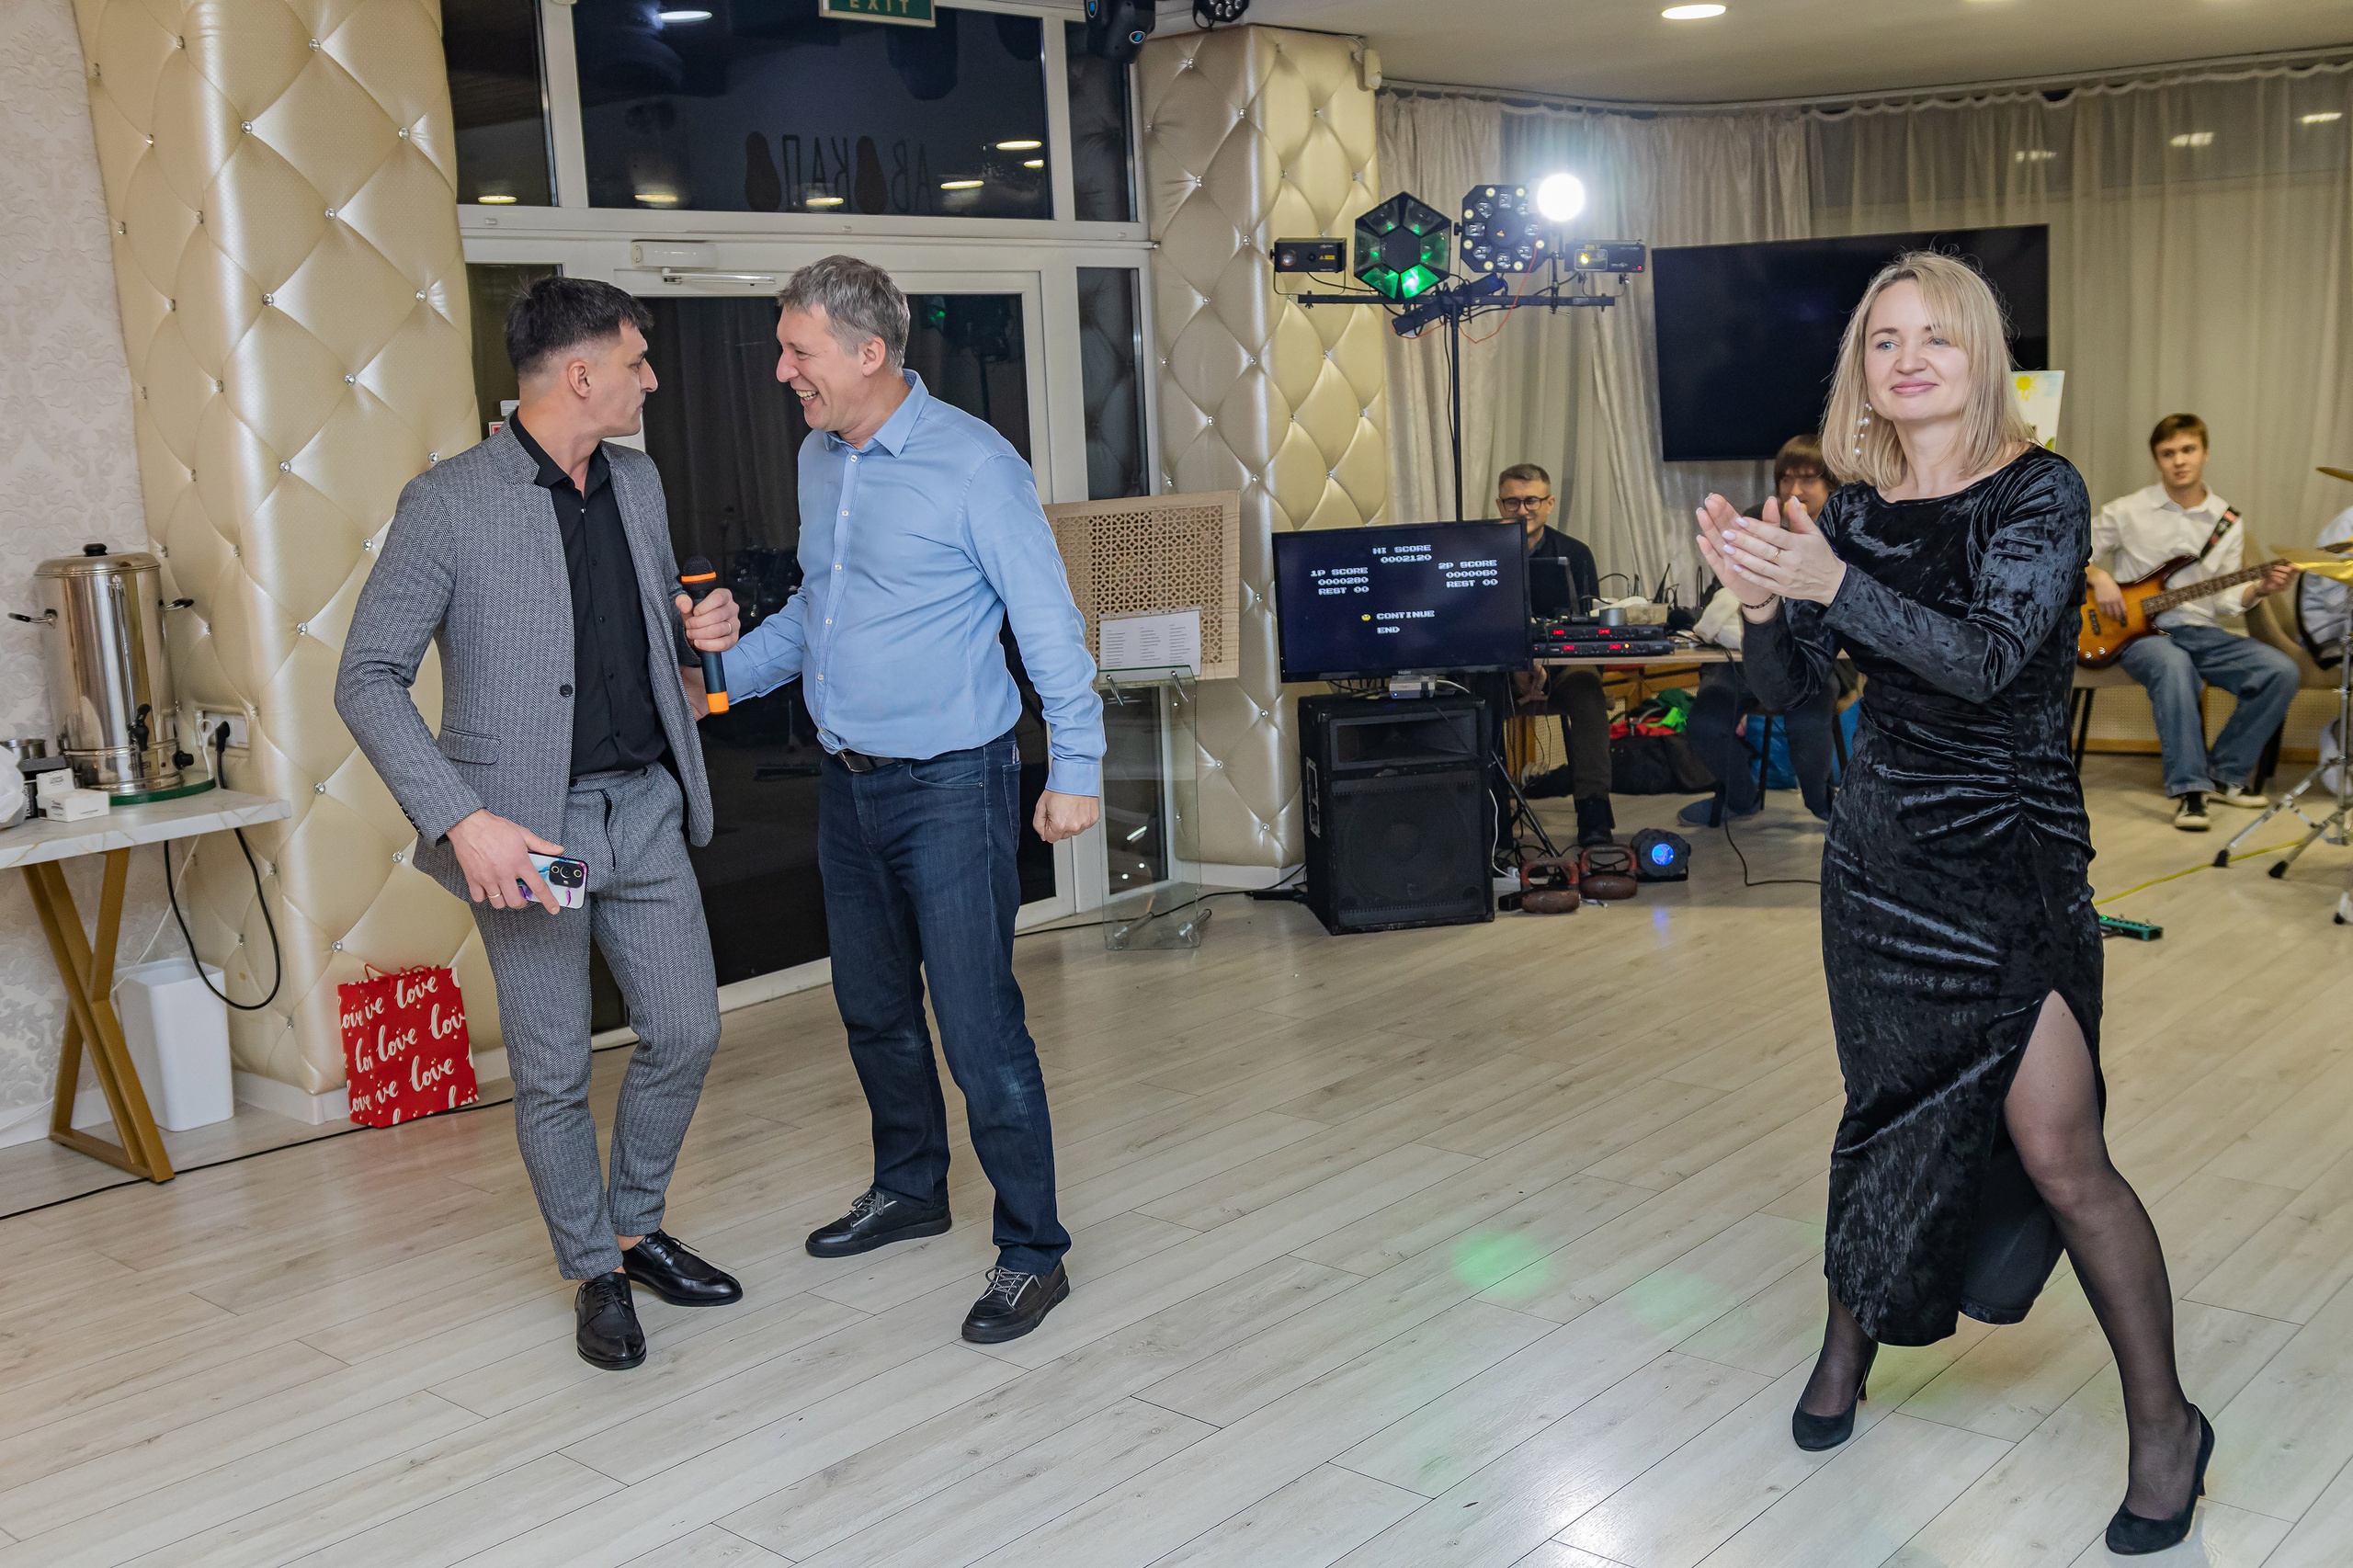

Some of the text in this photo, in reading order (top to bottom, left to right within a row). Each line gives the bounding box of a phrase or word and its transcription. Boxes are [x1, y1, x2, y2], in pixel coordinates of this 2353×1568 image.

[1372, 544, 1432, 555] HI SCORE
[1381, 553, 1432, 563] 0002120
[1438, 560, 1497, 570] 2P SCORE
[1310, 567, 1369, 577] 1P SCORE
[1446, 578, 1499, 588] REST 00
[1318, 585, 1370, 596] REST 00
[1376, 609, 1436, 620] CONTINUE
[1377, 626, 1401, 634] END
[394, 976, 438, 1009] love
[376, 1025, 418, 1062] love
[409, 1055, 455, 1092] love
